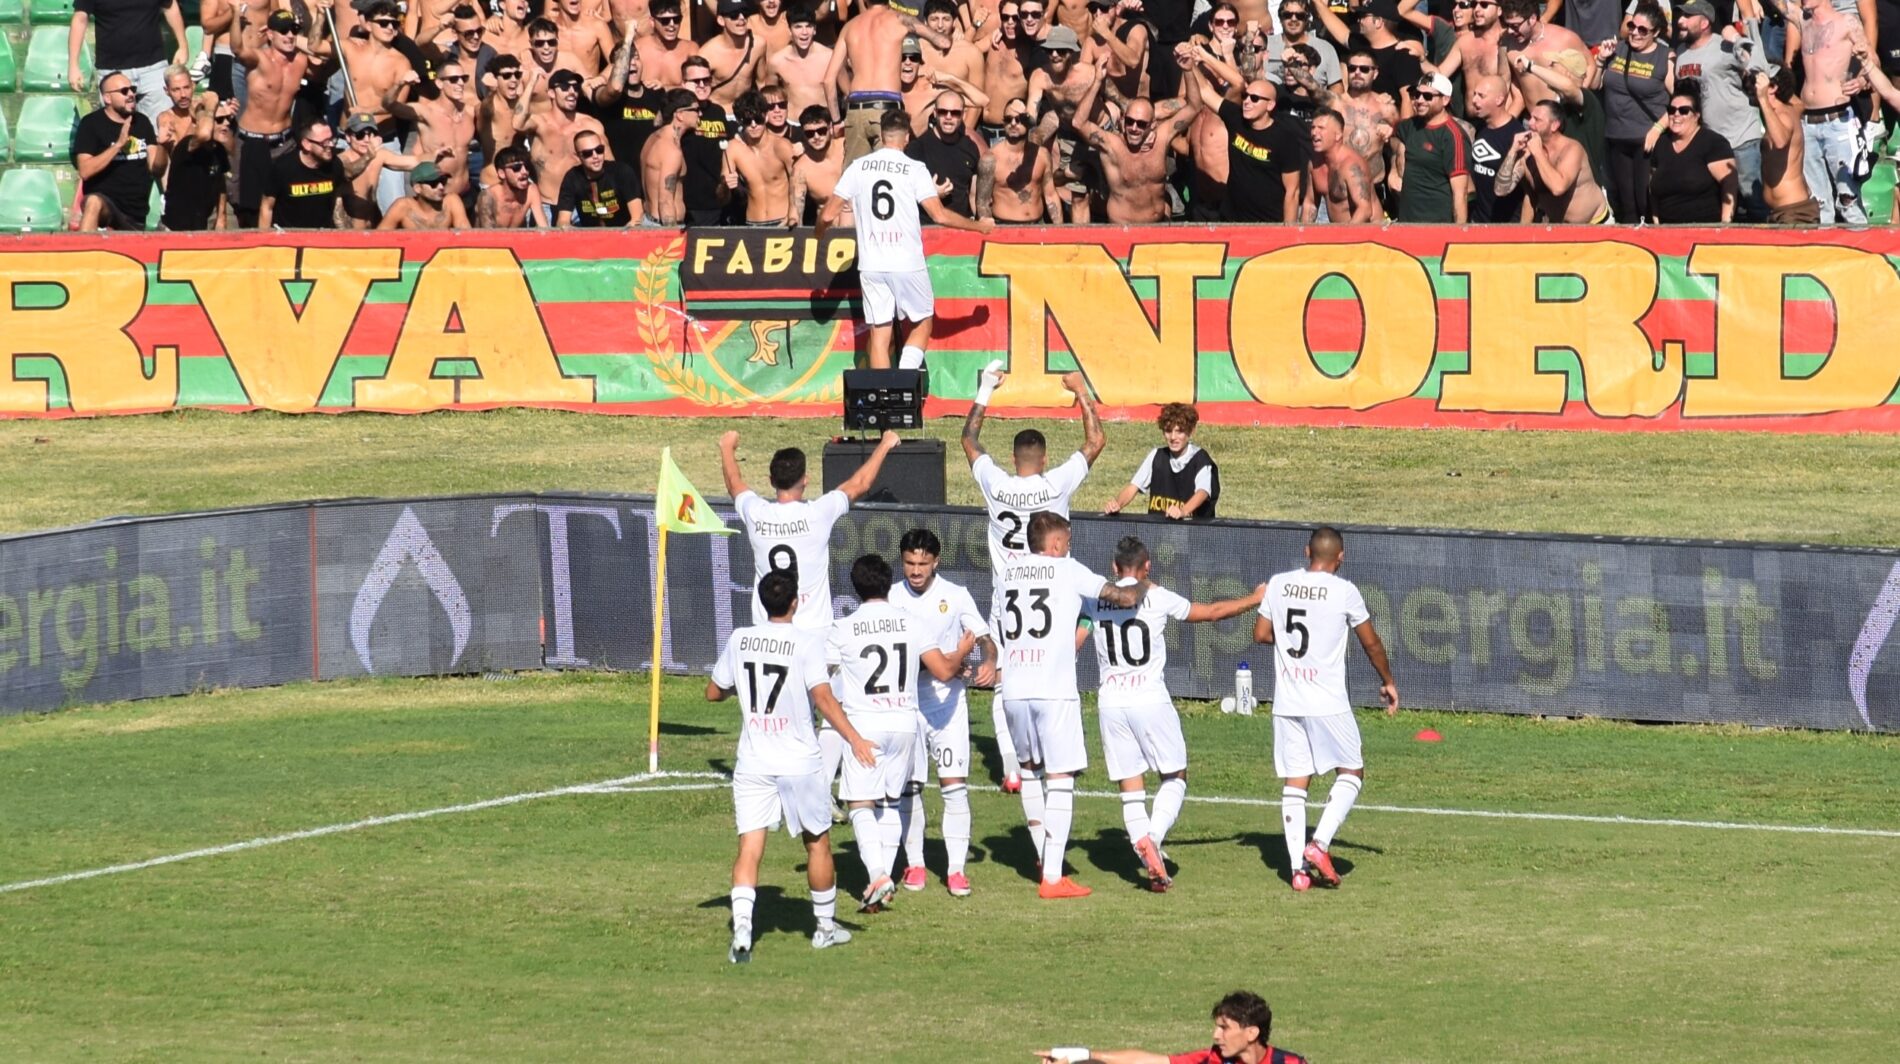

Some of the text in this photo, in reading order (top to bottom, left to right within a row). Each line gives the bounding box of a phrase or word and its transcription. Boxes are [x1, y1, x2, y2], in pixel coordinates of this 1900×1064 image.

[861, 159, 911, 175] DANESE
[1474, 163, 1495, 177] mbro
[871, 179, 895, 221] 6
[694, 236, 856, 274] FABIO
[979, 240, 1900, 418] NORD
[997, 489, 1050, 507] BONACCHI
[755, 518, 810, 537] PETTINARI
[1282, 583, 1328, 601] SABER
[853, 618, 907, 637] BALLABILE
[1005, 588, 1052, 640] 33
[1286, 607, 1310, 659] 5
[740, 636, 795, 656] BIONDINI
[1099, 618, 1151, 667] 10
[743, 661, 790, 714] 17
[860, 642, 907, 695] 21
